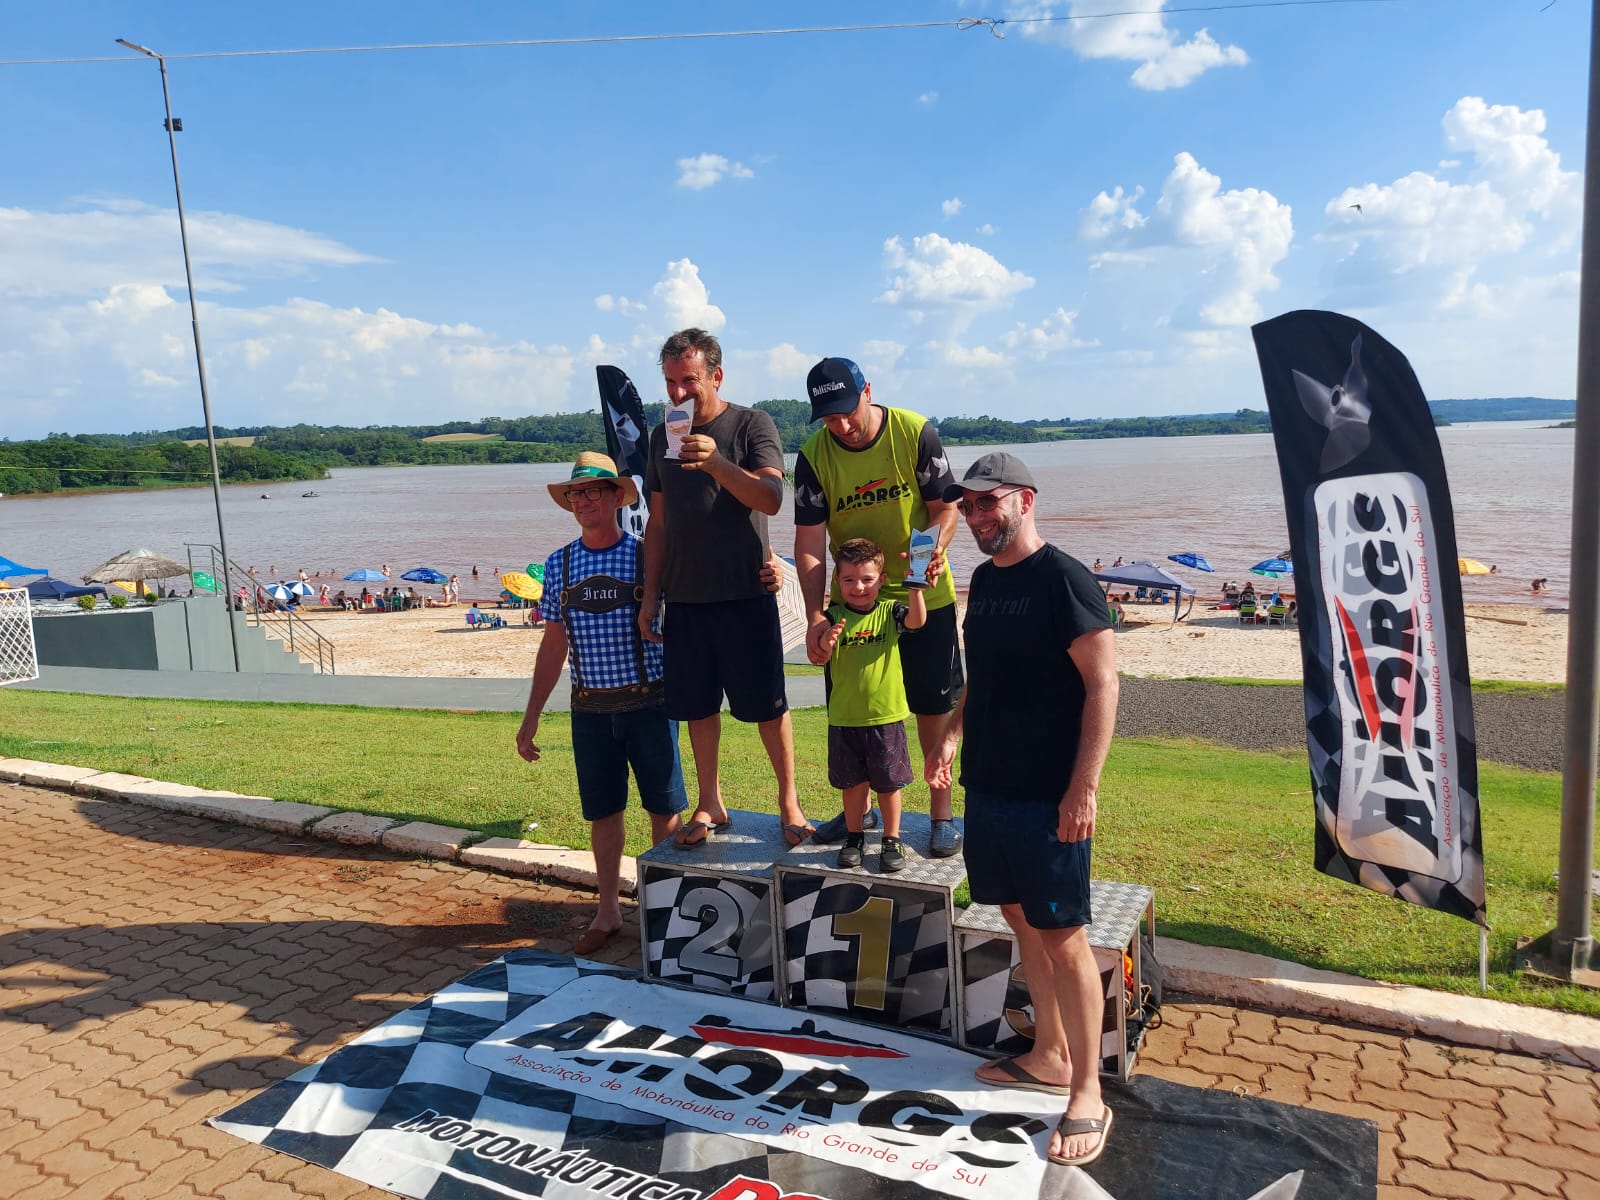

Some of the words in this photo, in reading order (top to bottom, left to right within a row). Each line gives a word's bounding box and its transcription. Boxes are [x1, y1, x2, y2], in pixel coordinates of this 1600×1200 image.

[1408, 505, 1422, 523] Sul
[1413, 531, 1425, 548] do
[1416, 555, 1432, 604] Grande
[1424, 612, 1434, 632] Rio
[1426, 640, 1438, 656] do
[1353, 492, 1439, 861] AMORGS
[1430, 665, 1446, 745] Motonáutica
[1440, 752, 1448, 769] de
[1440, 776, 1453, 848] Associação
[678, 887, 742, 981] 2
[832, 896, 894, 1011] 1
[504, 1011, 1049, 1169] AMORGS
[505, 1053, 592, 1081] Associação
[599, 1077, 622, 1091] de
[630, 1085, 736, 1122] Motonáutica
[745, 1107, 769, 1130] do
[781, 1122, 810, 1140] Rio
[823, 1134, 899, 1164] Grande
[911, 1159, 939, 1172] do
[952, 1168, 988, 1188] Sul
